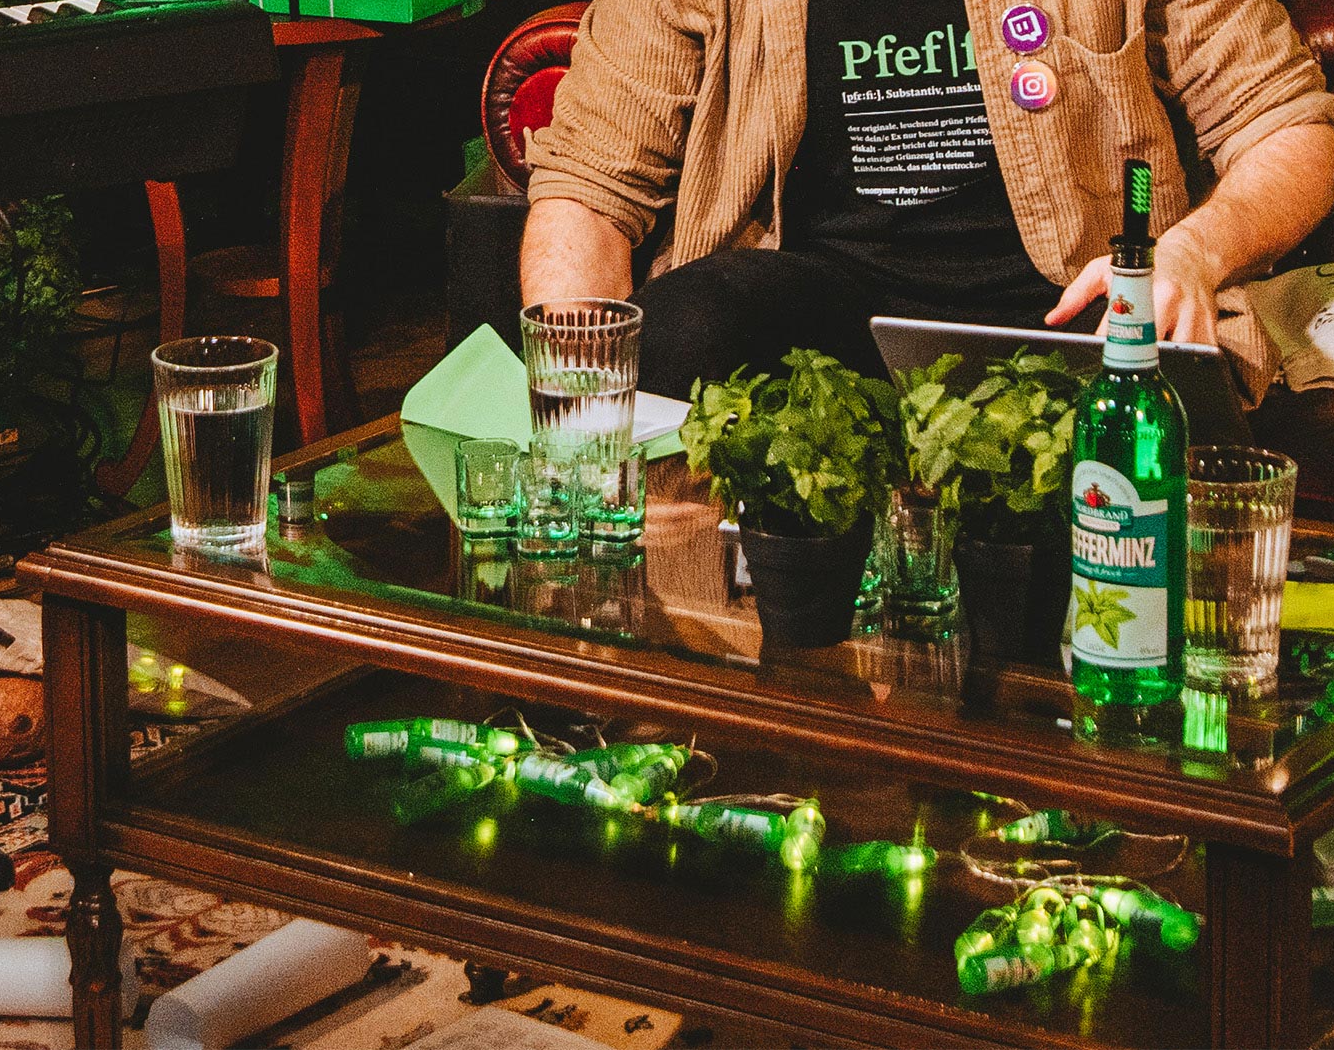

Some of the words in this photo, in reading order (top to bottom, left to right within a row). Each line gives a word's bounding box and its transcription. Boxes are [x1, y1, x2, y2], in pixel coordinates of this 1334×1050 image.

[885, 85, 944, 100] Substantiv,
[940, 117, 964, 128] grüne
[890, 133, 902, 141] Ex
[901, 141, 926, 150] bricht
[927, 139, 939, 148] dir
[940, 138, 961, 147] nicht
[962, 137, 976, 146] das
[852, 154, 866, 163] das
[935, 150, 944, 158] in
[944, 149, 974, 158] deinem
[942, 160, 987, 170] vertrocknet
[898, 186, 919, 196] Party
